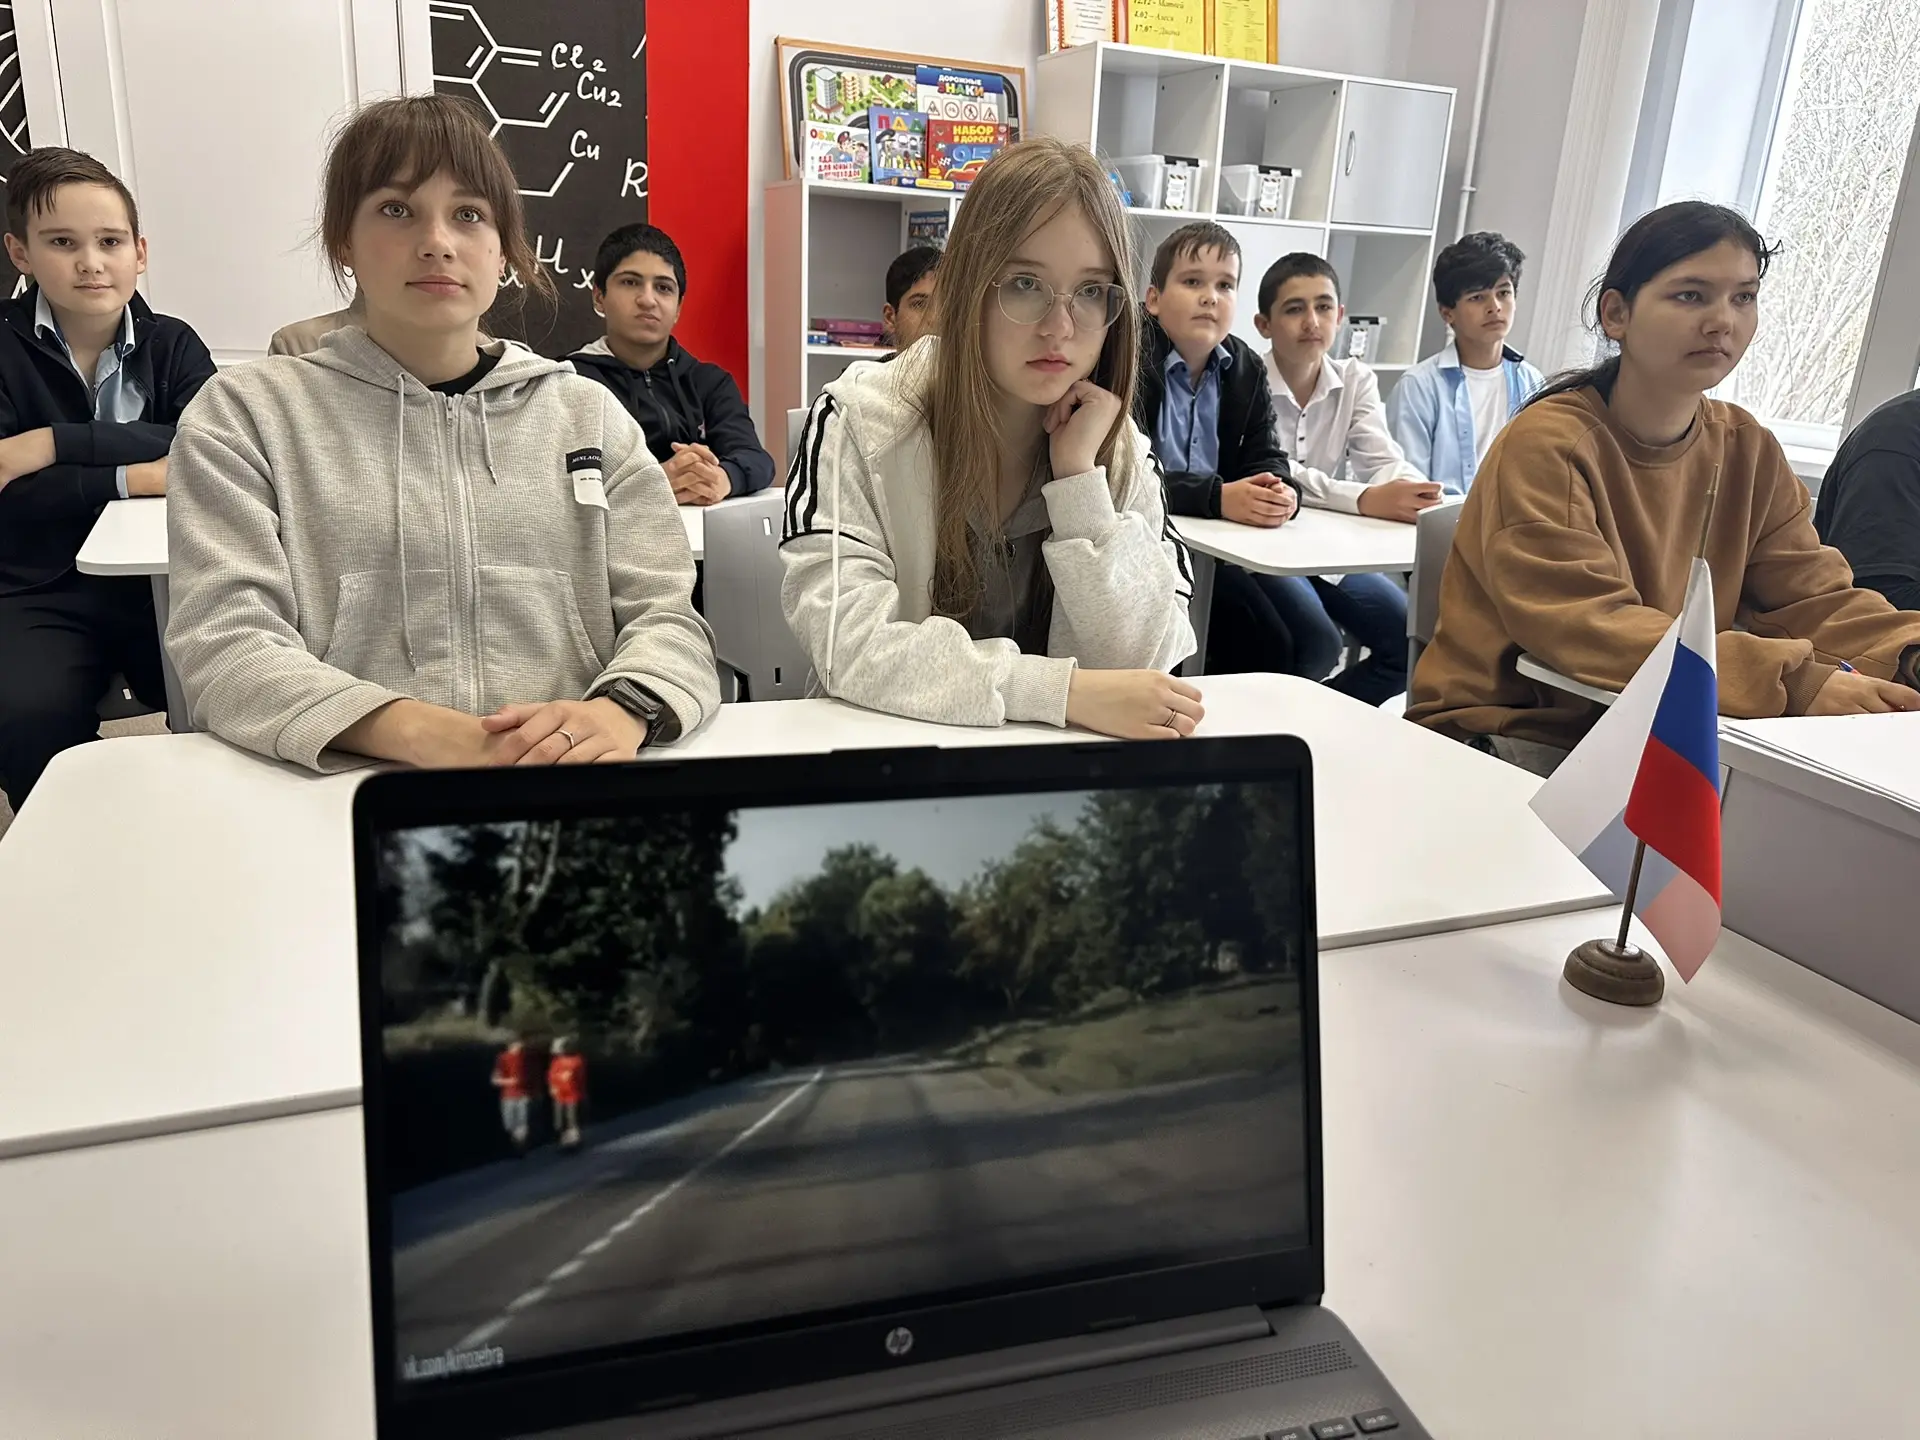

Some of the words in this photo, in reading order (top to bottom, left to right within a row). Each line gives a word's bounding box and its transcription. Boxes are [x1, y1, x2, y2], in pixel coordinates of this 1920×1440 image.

[938, 74, 982, 86] ДОРОЖНЫЕ
[938, 81, 984, 98] ЗНАКИ
[810, 128, 836, 142] ОБЖ
[953, 124, 994, 136] НАБОР
[569, 129, 600, 160] Cu
[960, 136, 995, 144] ДОРОГУ
